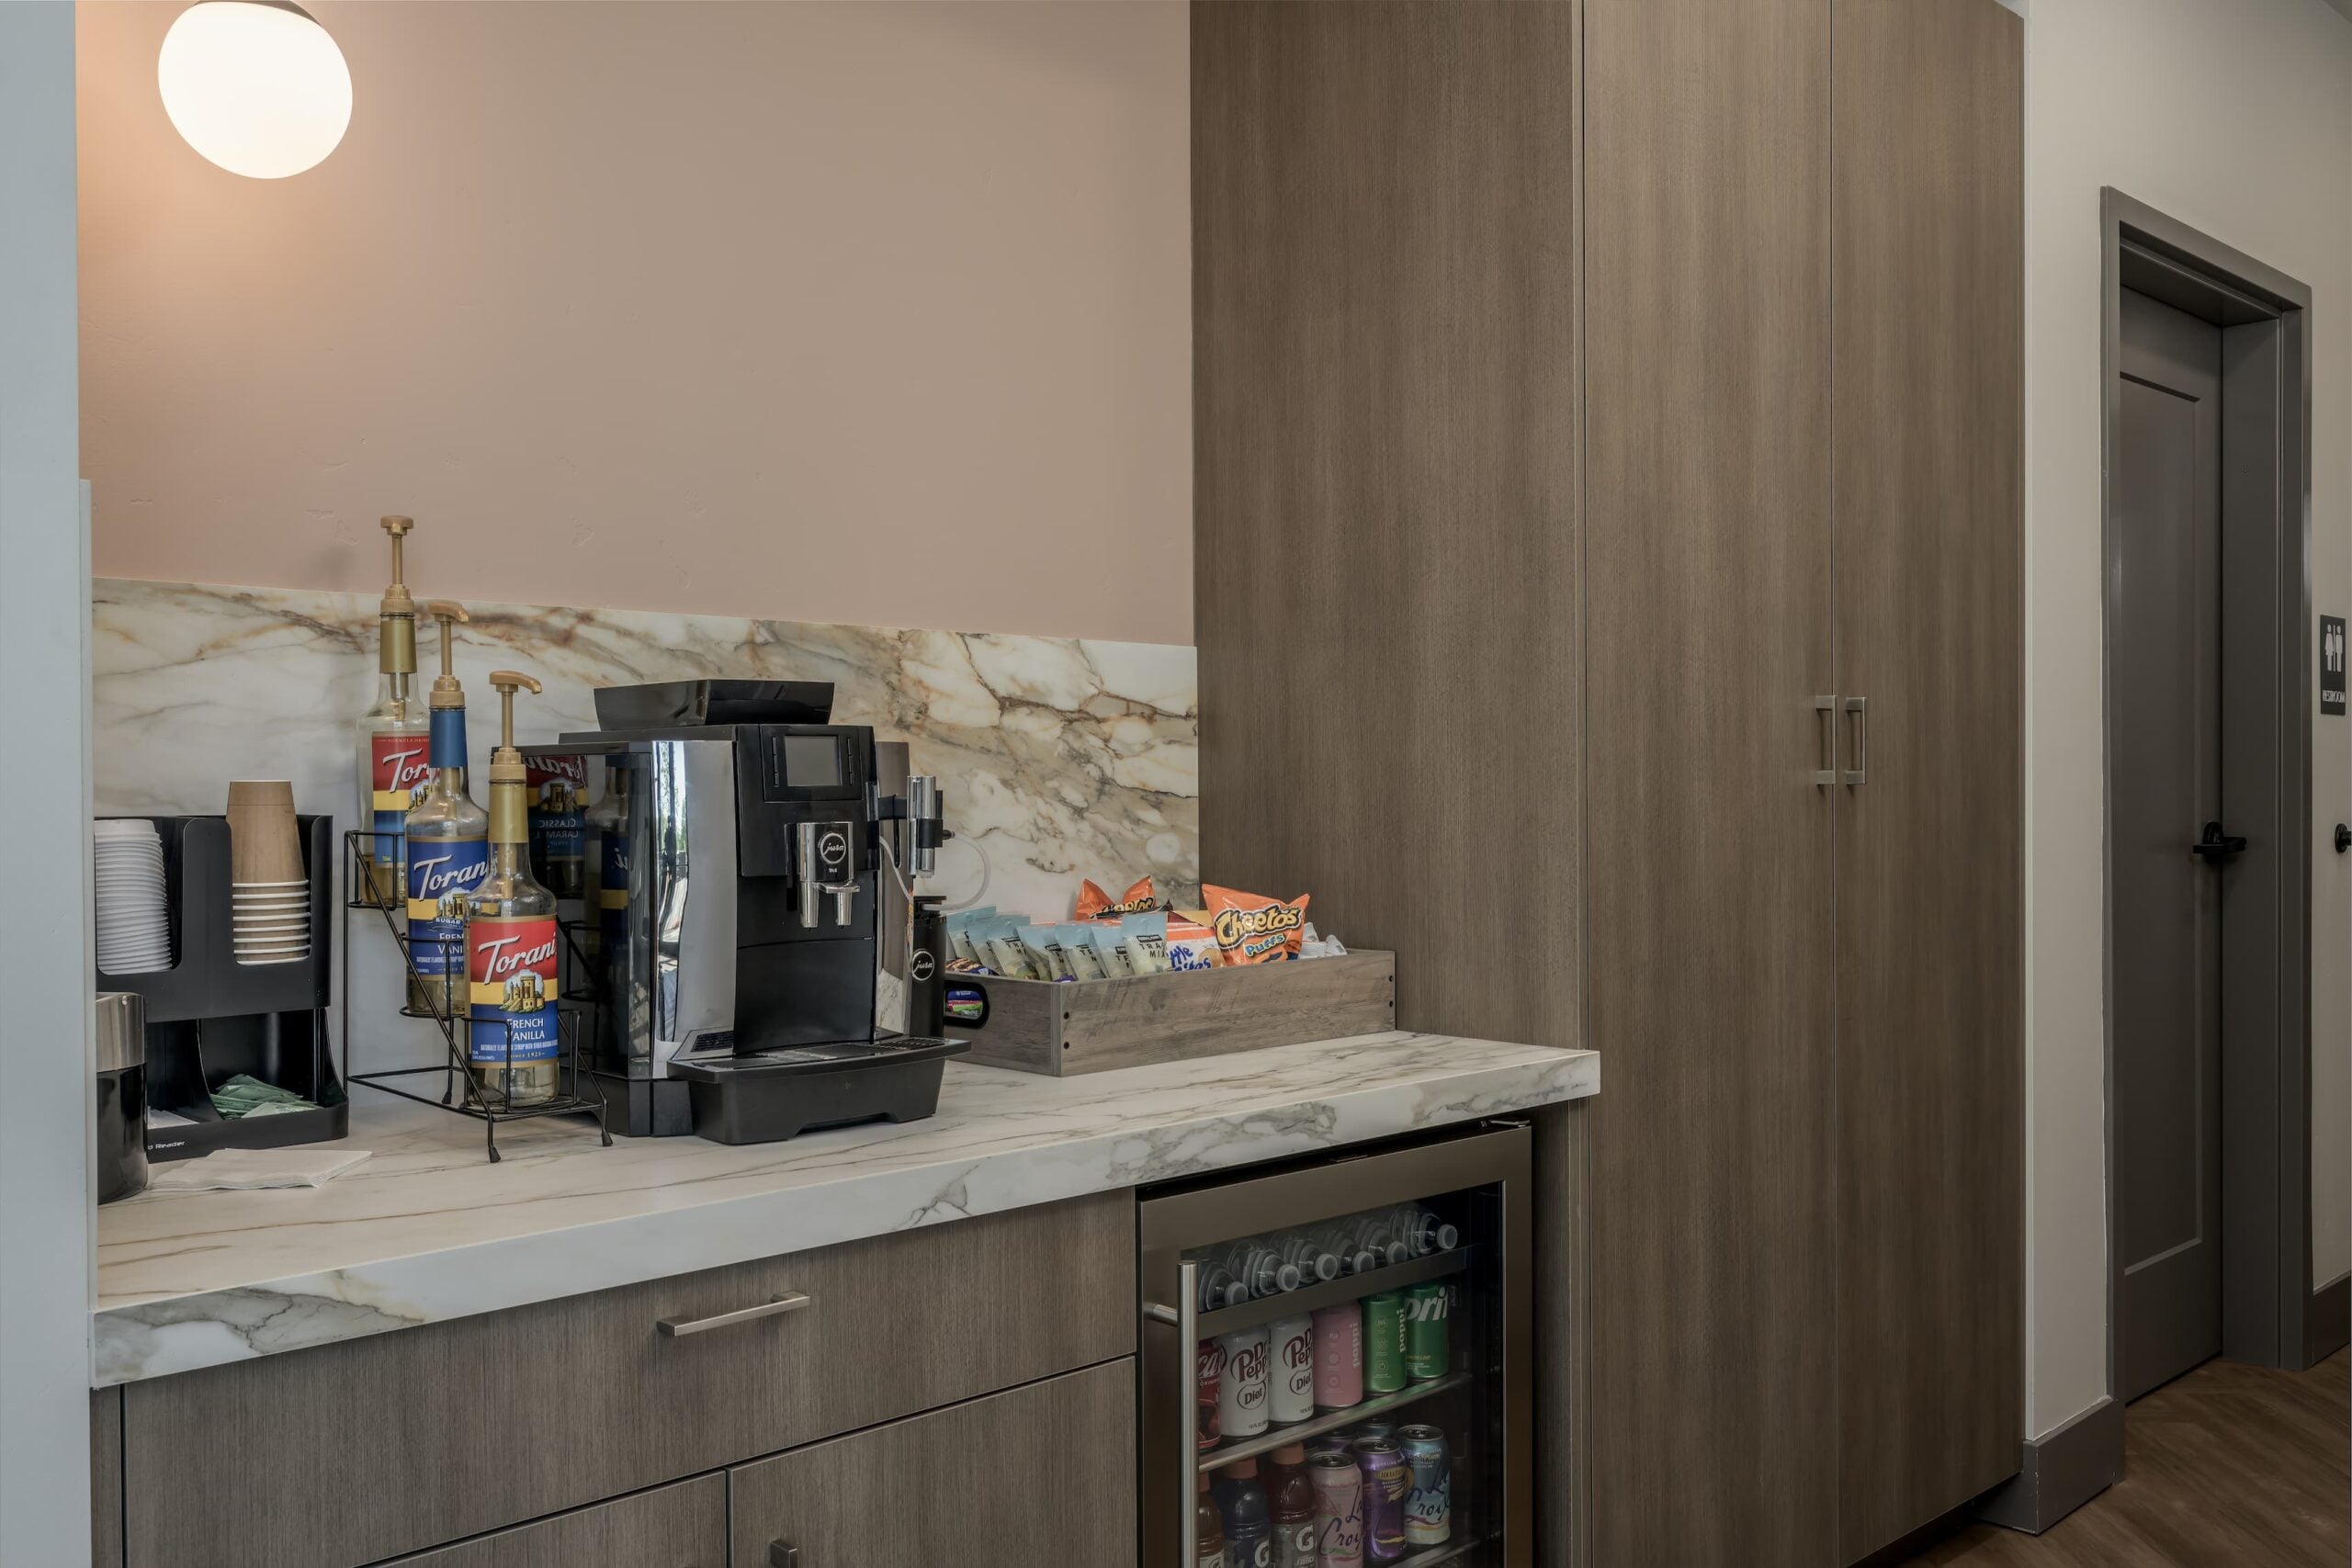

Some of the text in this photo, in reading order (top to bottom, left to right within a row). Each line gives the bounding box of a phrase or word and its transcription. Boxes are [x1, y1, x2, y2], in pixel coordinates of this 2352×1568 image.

[1216, 907, 1299, 946] Cheetos
[1245, 933, 1285, 957] Puffs
[478, 931, 556, 985] Torani
[1350, 1323, 1360, 1368] poppi
[1396, 1308, 1406, 1352] poppi
